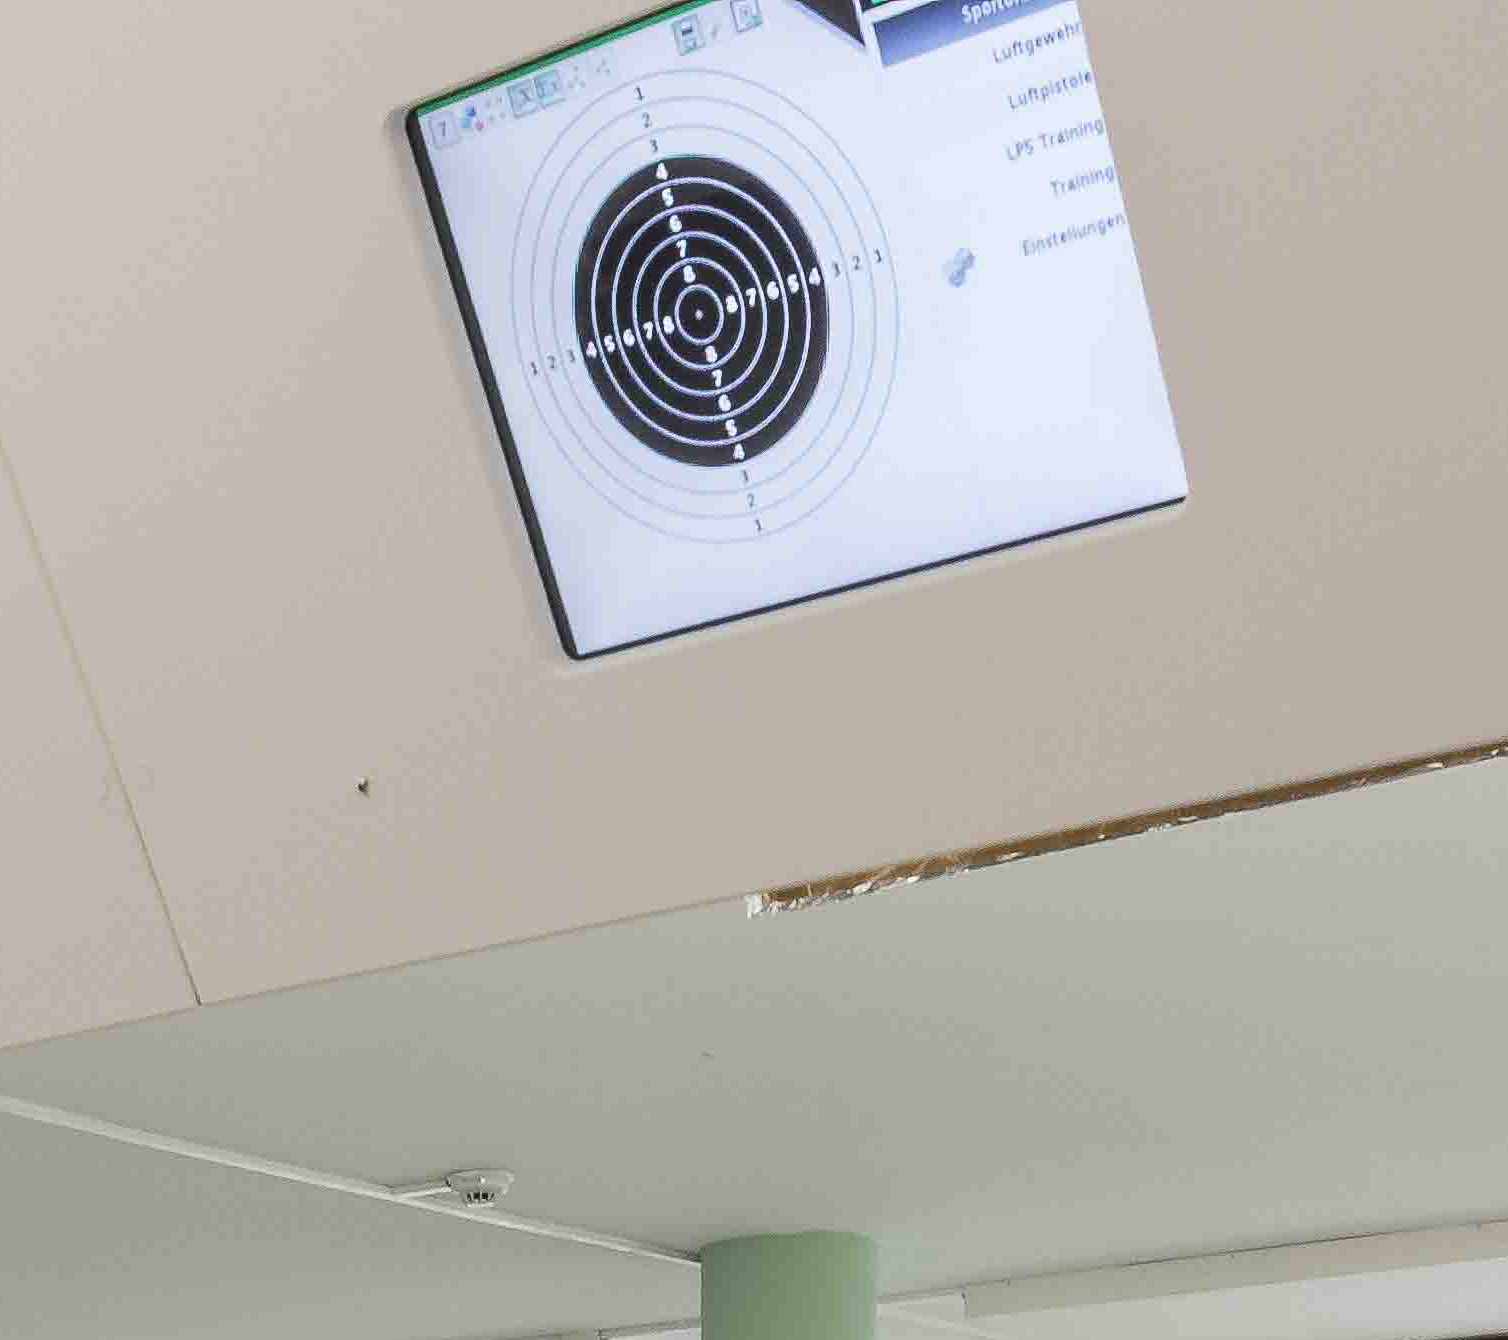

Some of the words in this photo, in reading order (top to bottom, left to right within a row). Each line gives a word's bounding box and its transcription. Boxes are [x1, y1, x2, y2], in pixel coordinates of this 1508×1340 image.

[1007, 71, 1092, 112] Luftpistole
[1039, 117, 1104, 151] Training
[1050, 165, 1115, 197] Training
[1022, 212, 1126, 256] Einstellungen
